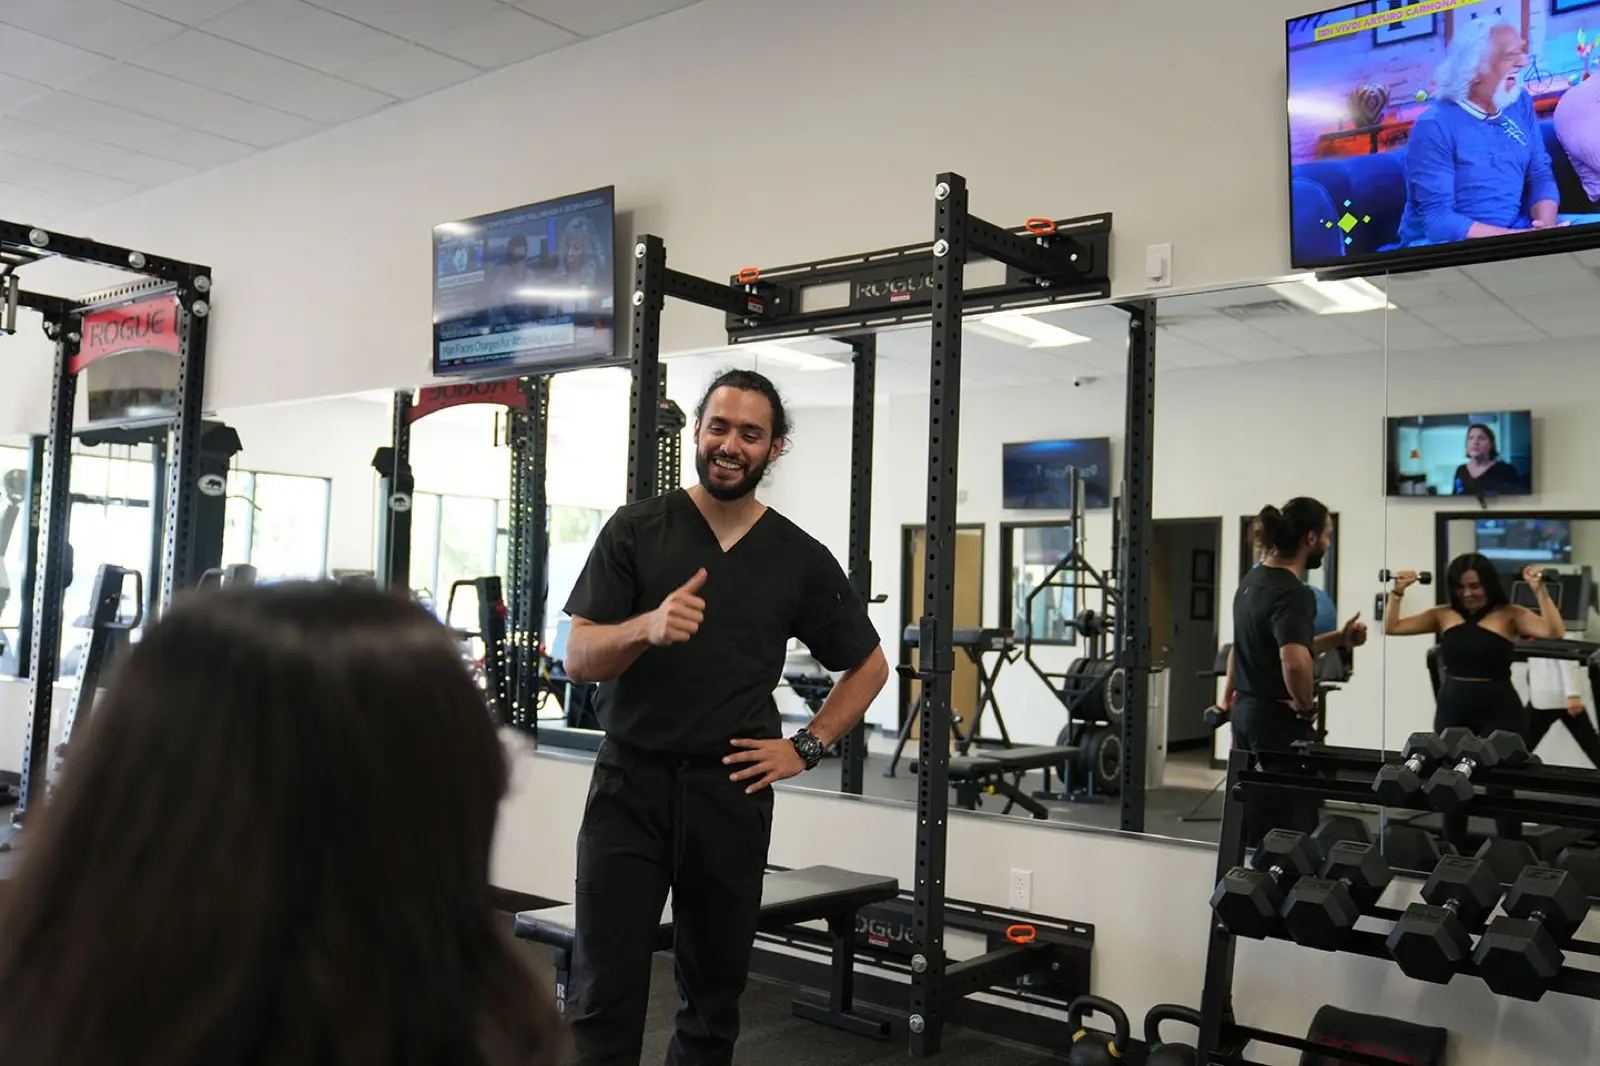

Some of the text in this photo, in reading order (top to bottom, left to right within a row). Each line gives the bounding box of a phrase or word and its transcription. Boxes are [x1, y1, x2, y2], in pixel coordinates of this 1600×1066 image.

[1364, 11, 1403, 27] ARTURO
[89, 308, 166, 348] ROGUE
[855, 917, 914, 943] OGUE
